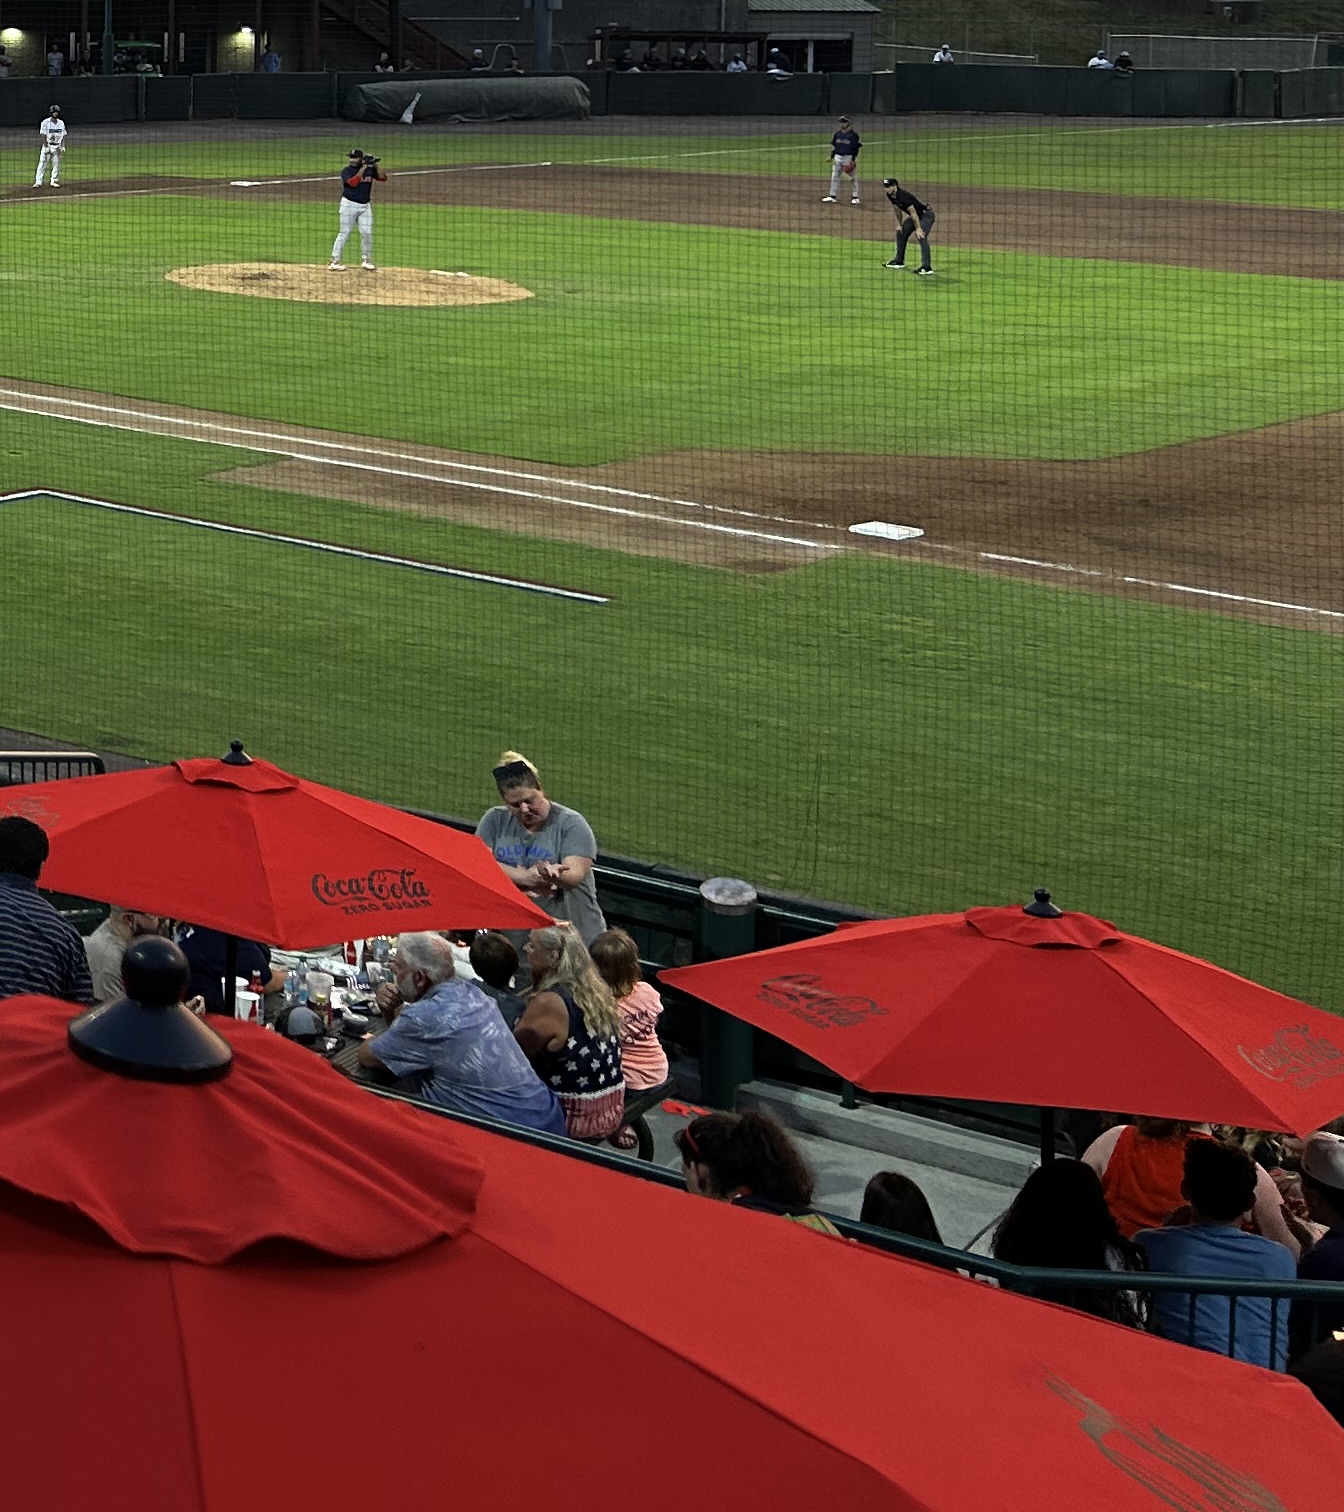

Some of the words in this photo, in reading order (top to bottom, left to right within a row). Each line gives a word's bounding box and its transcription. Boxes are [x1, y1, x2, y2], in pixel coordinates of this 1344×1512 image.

[312, 867, 430, 907] Coca-Cola
[341, 902, 380, 916] ZERO
[382, 899, 433, 911] SUGAR
